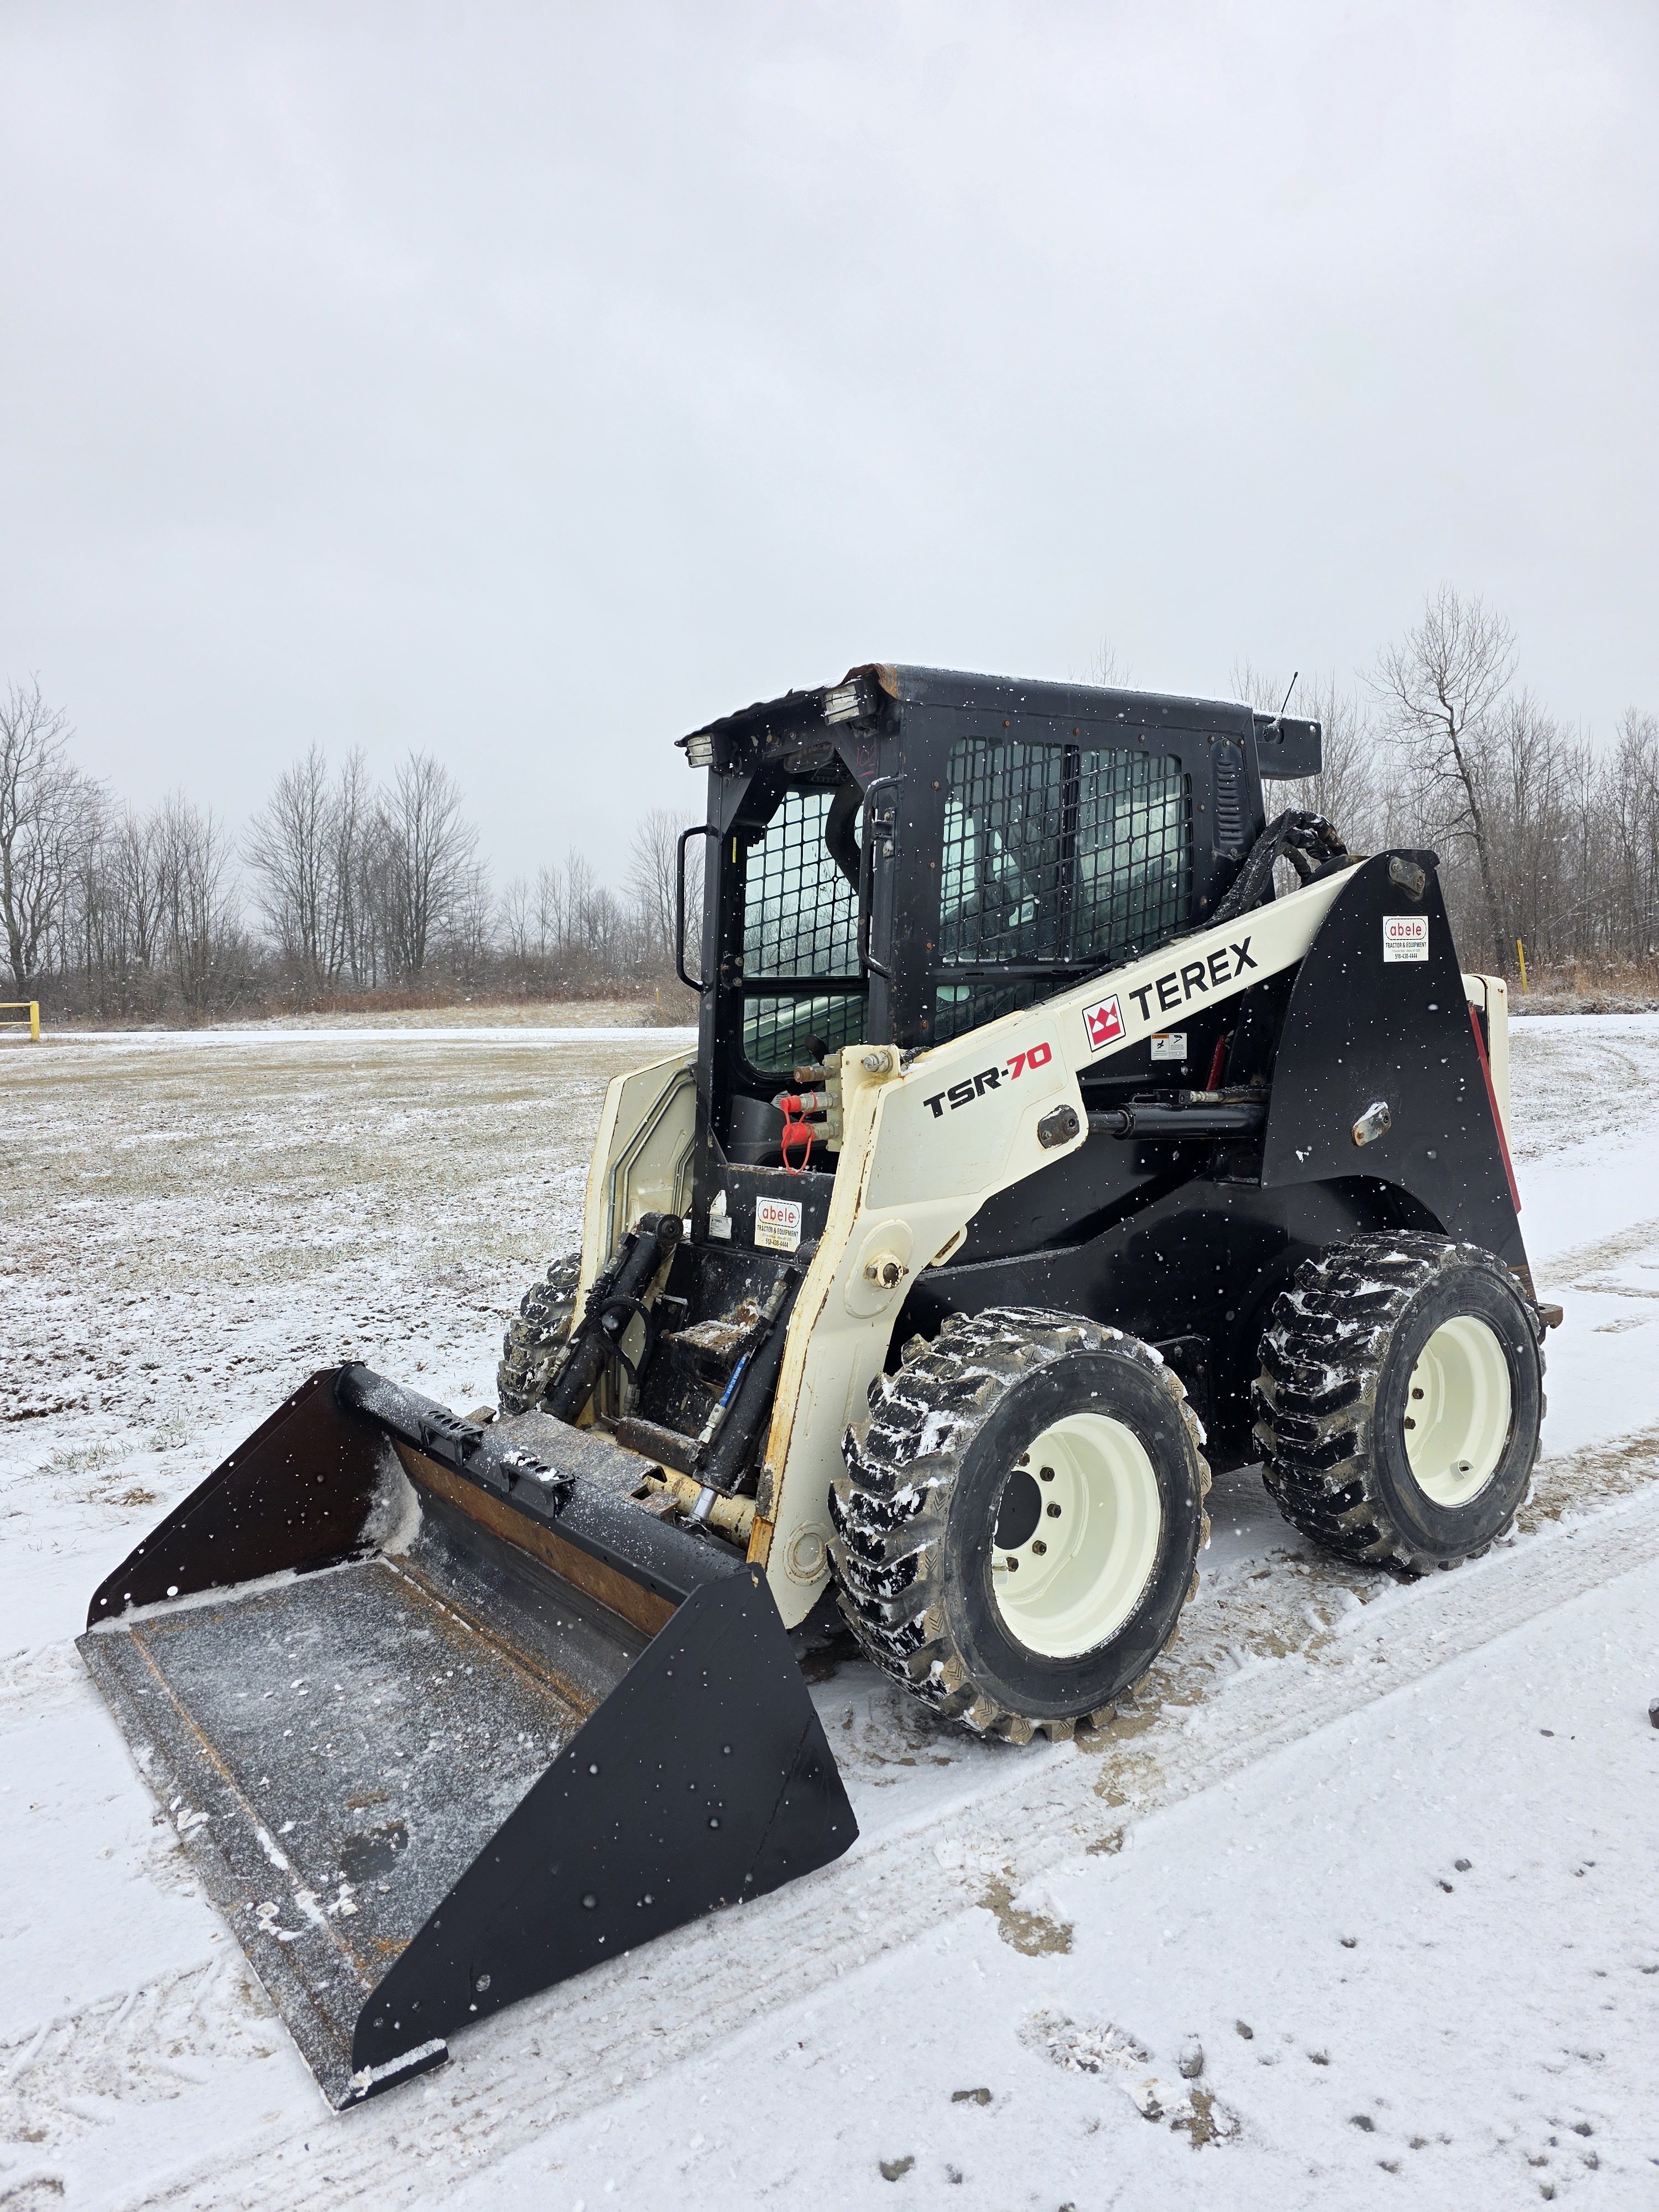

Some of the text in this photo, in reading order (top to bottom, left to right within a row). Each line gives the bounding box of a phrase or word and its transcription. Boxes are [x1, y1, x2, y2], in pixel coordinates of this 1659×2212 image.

[1390, 922, 1421, 936] abele
[1129, 936, 1258, 1021] TEREX
[923, 1042, 1052, 1119] TSR-70
[763, 1206, 795, 1223] abele
[757, 1224, 773, 1233] TRACTOR
[777, 1228, 799, 1238] EQUIPMENT
